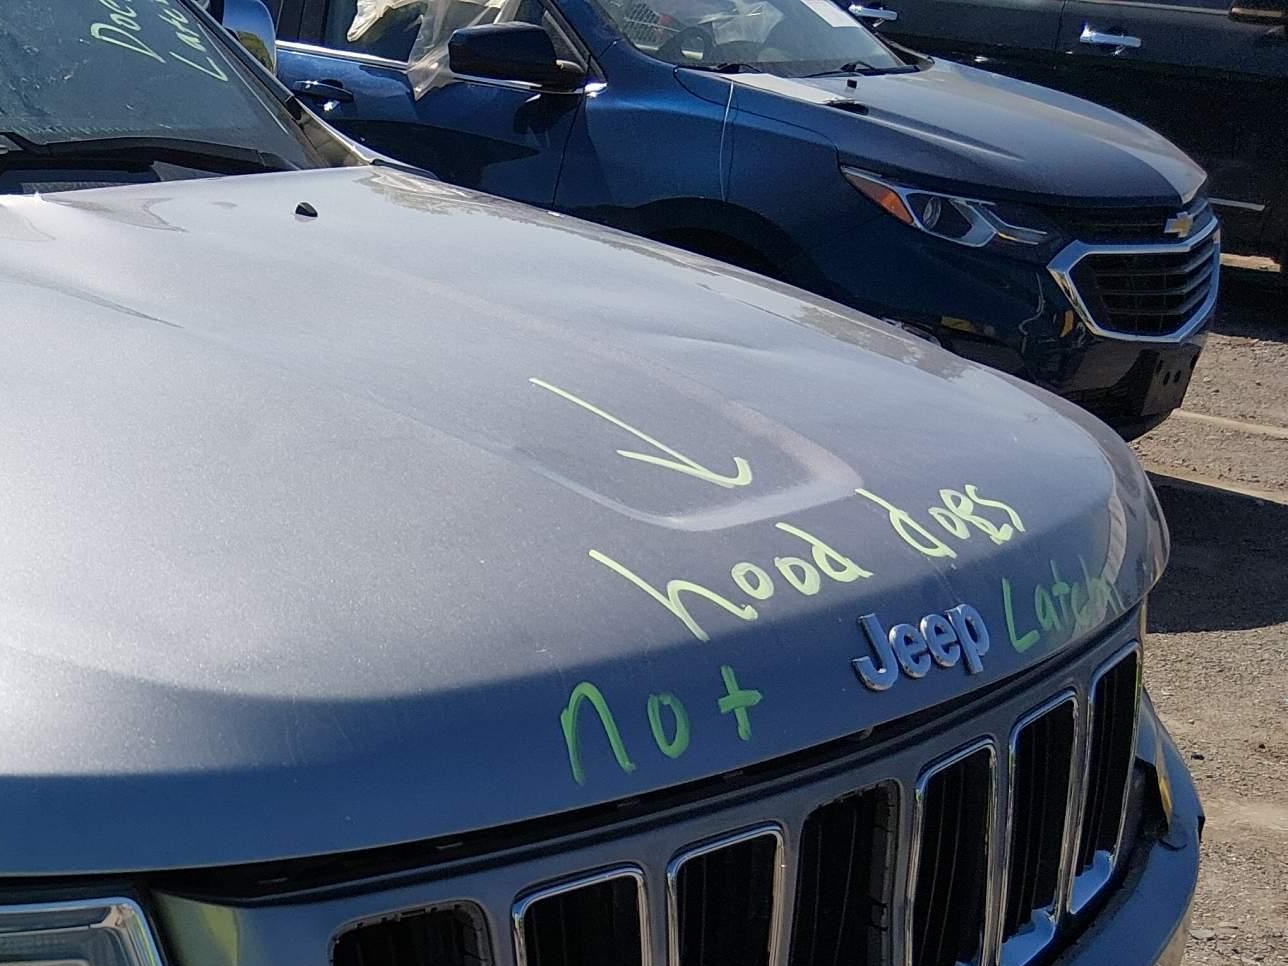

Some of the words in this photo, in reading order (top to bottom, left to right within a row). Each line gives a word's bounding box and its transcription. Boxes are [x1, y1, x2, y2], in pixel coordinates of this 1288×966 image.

[588, 521, 874, 641] hood
[855, 484, 1026, 559] does
[559, 664, 763, 787] not
[1002, 554, 1126, 653] Latch
[853, 603, 990, 691] Jeep
